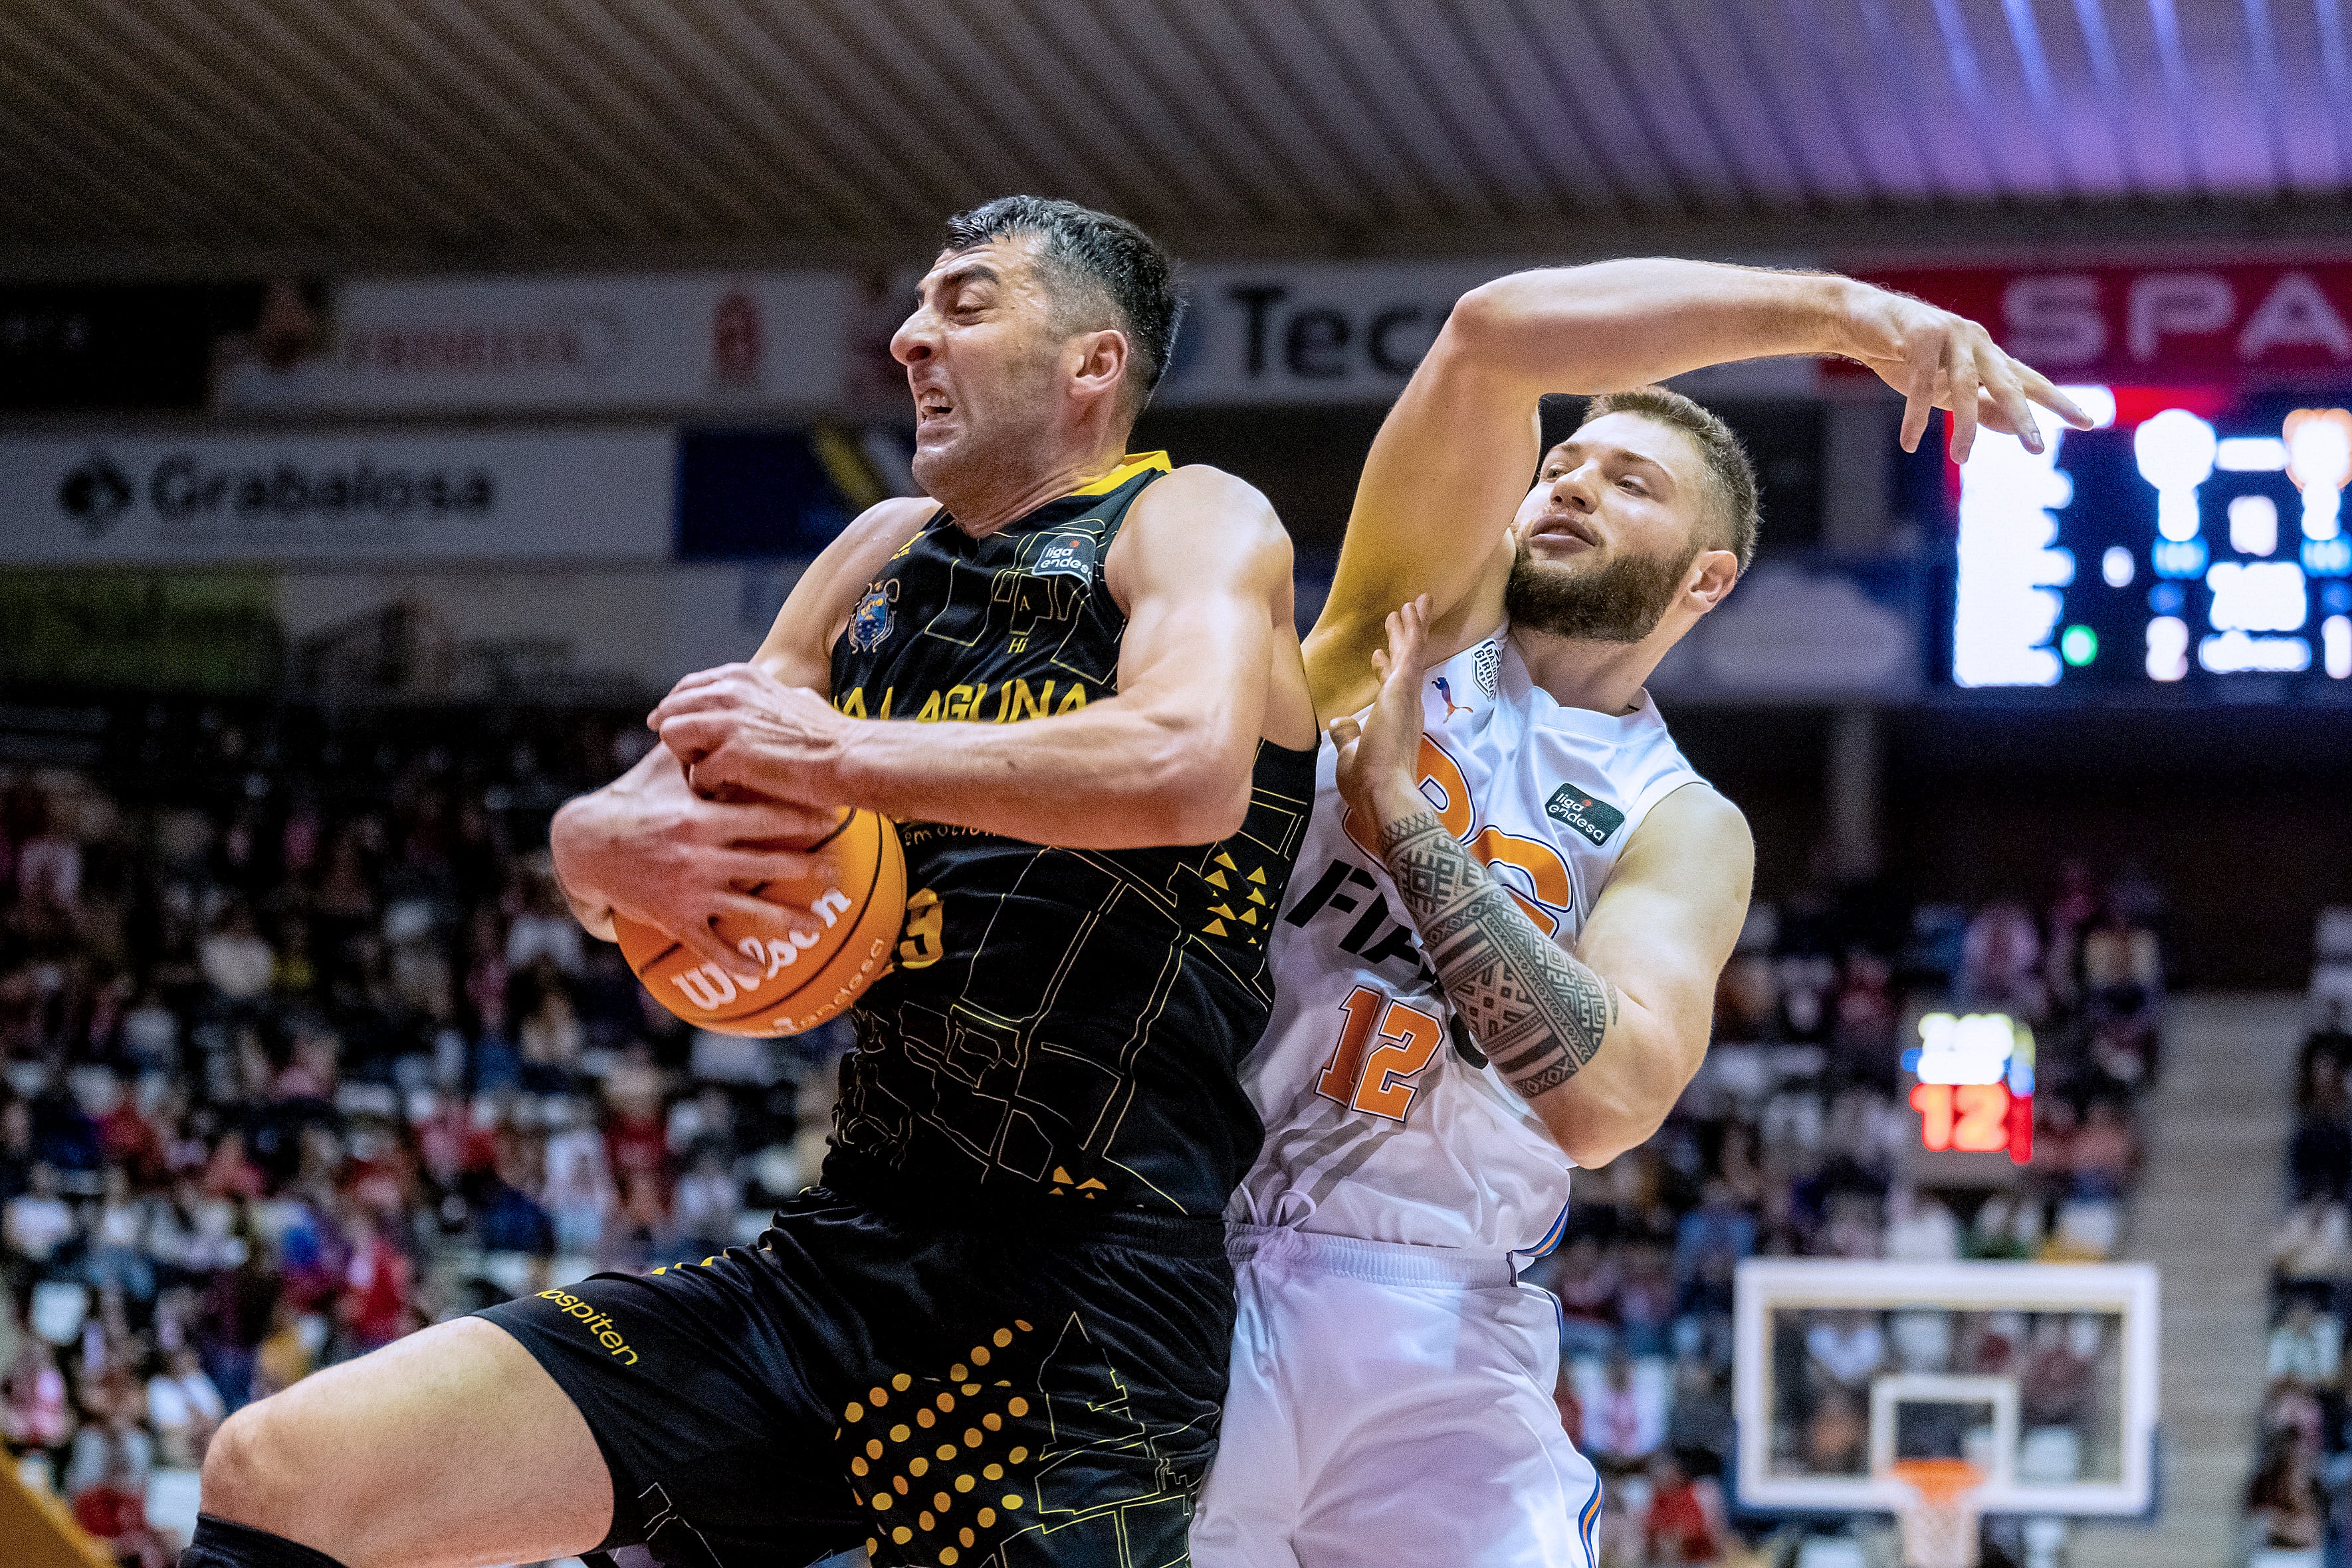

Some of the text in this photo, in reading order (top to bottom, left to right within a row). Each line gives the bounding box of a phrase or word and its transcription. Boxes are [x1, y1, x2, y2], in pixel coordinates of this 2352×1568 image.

[1226, 284, 1457, 380] Tec
[2000, 271, 2352, 362] SPA
[150, 453, 495, 521] Grabalosa
[1045, 547, 1073, 559] liga
[1473, 650, 1495, 699] GIRONA
[1549, 805, 1606, 840] endesa
[1555, 793, 1584, 812] liga
[1314, 984, 1445, 1124] 12
[1909, 1082, 2010, 1153] 12
